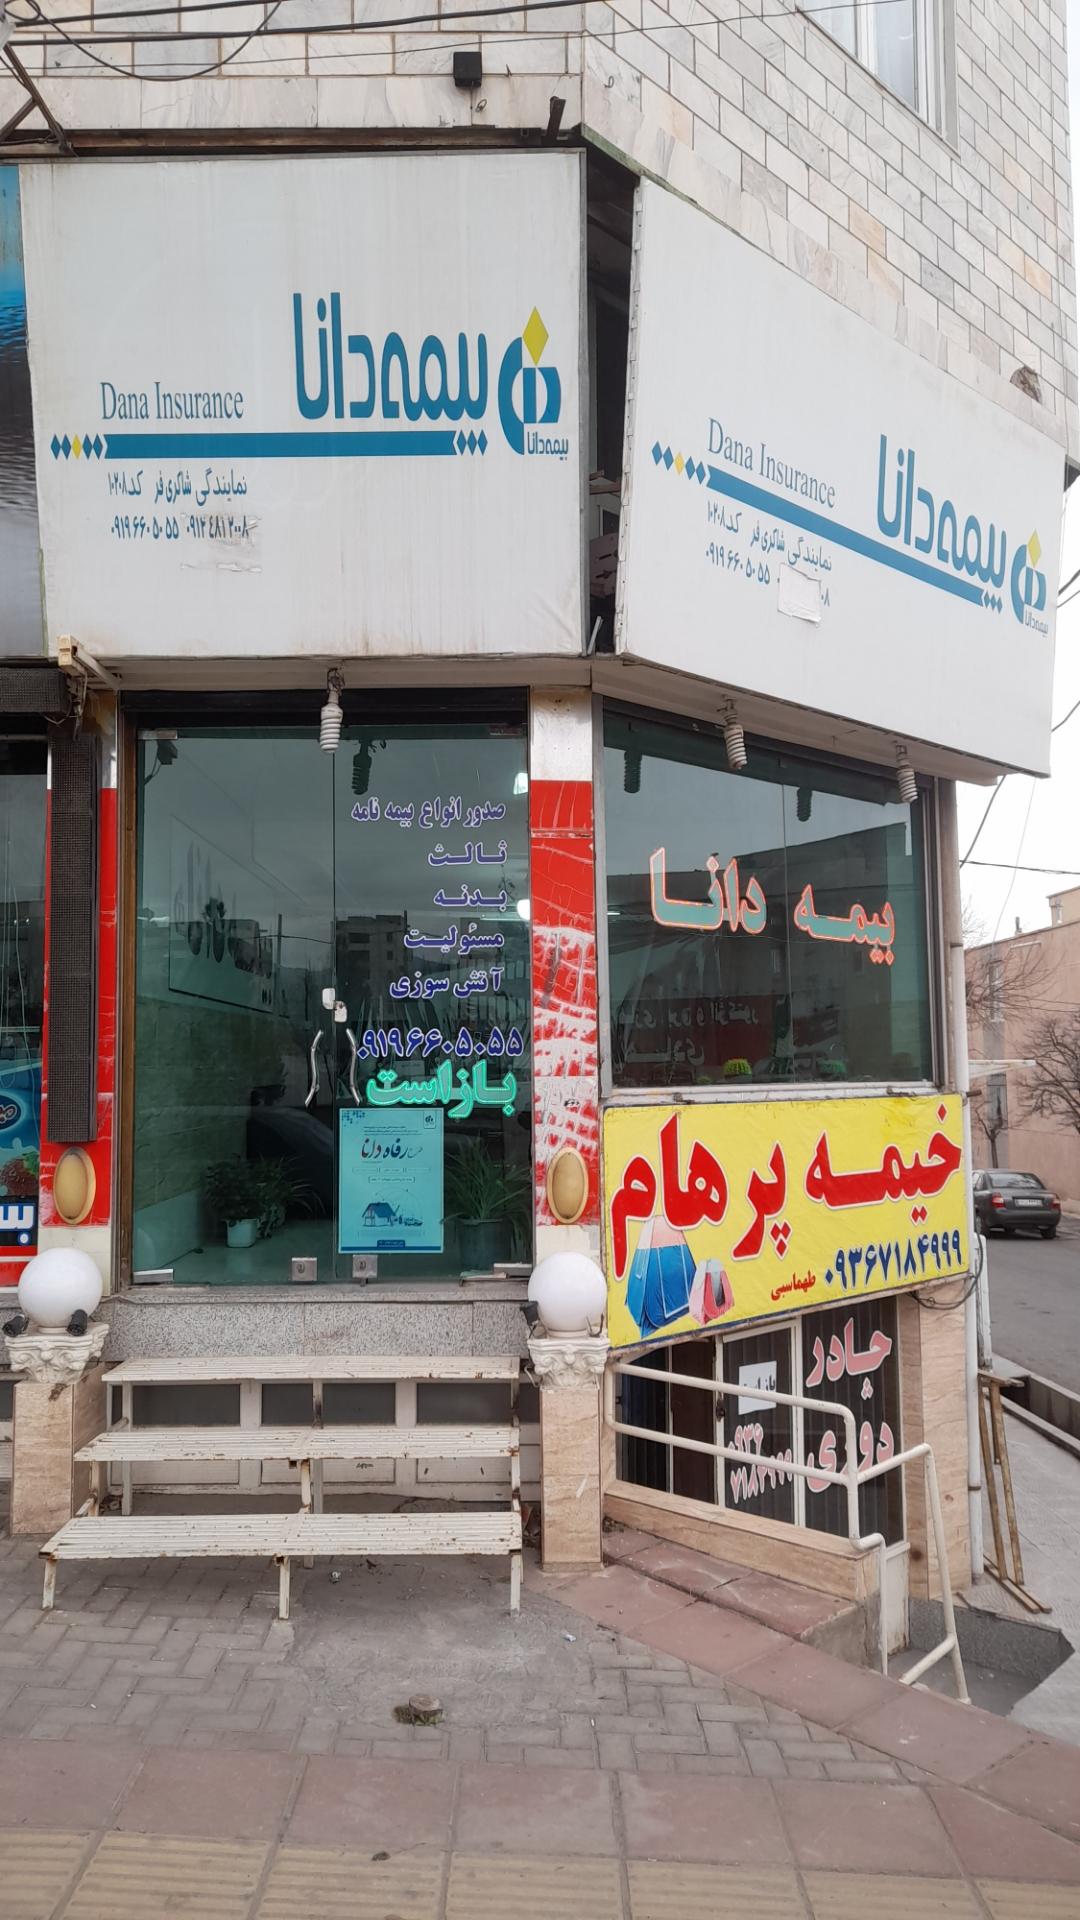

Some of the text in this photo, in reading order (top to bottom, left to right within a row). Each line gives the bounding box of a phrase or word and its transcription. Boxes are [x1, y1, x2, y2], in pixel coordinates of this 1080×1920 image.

[100, 382, 243, 420] Dana Insurance
[707, 417, 836, 508] Dana Insurance
[196, 467, 248, 507] نمایندگی
[787, 536, 832, 571] نمایندگی
[351, 796, 506, 828] صدور انواع بیمه نامه
[428, 840, 507, 866] ثالث
[433, 884, 507, 911] بدنه
[650, 847, 896, 965] بیمه دانا
[389, 971, 449, 999] سوزی
[357, 1026, 524, 1059] ۰۹۱۹۶۶۰۵۰۵۵
[610, 1102, 963, 1281] خیمه پرهام
[823, 1228, 963, 1292] ۰۹۳۶۷۱۸۴۹۹۹
[806, 1317, 893, 1400] چادر
[806, 1421, 895, 1493] دوی
